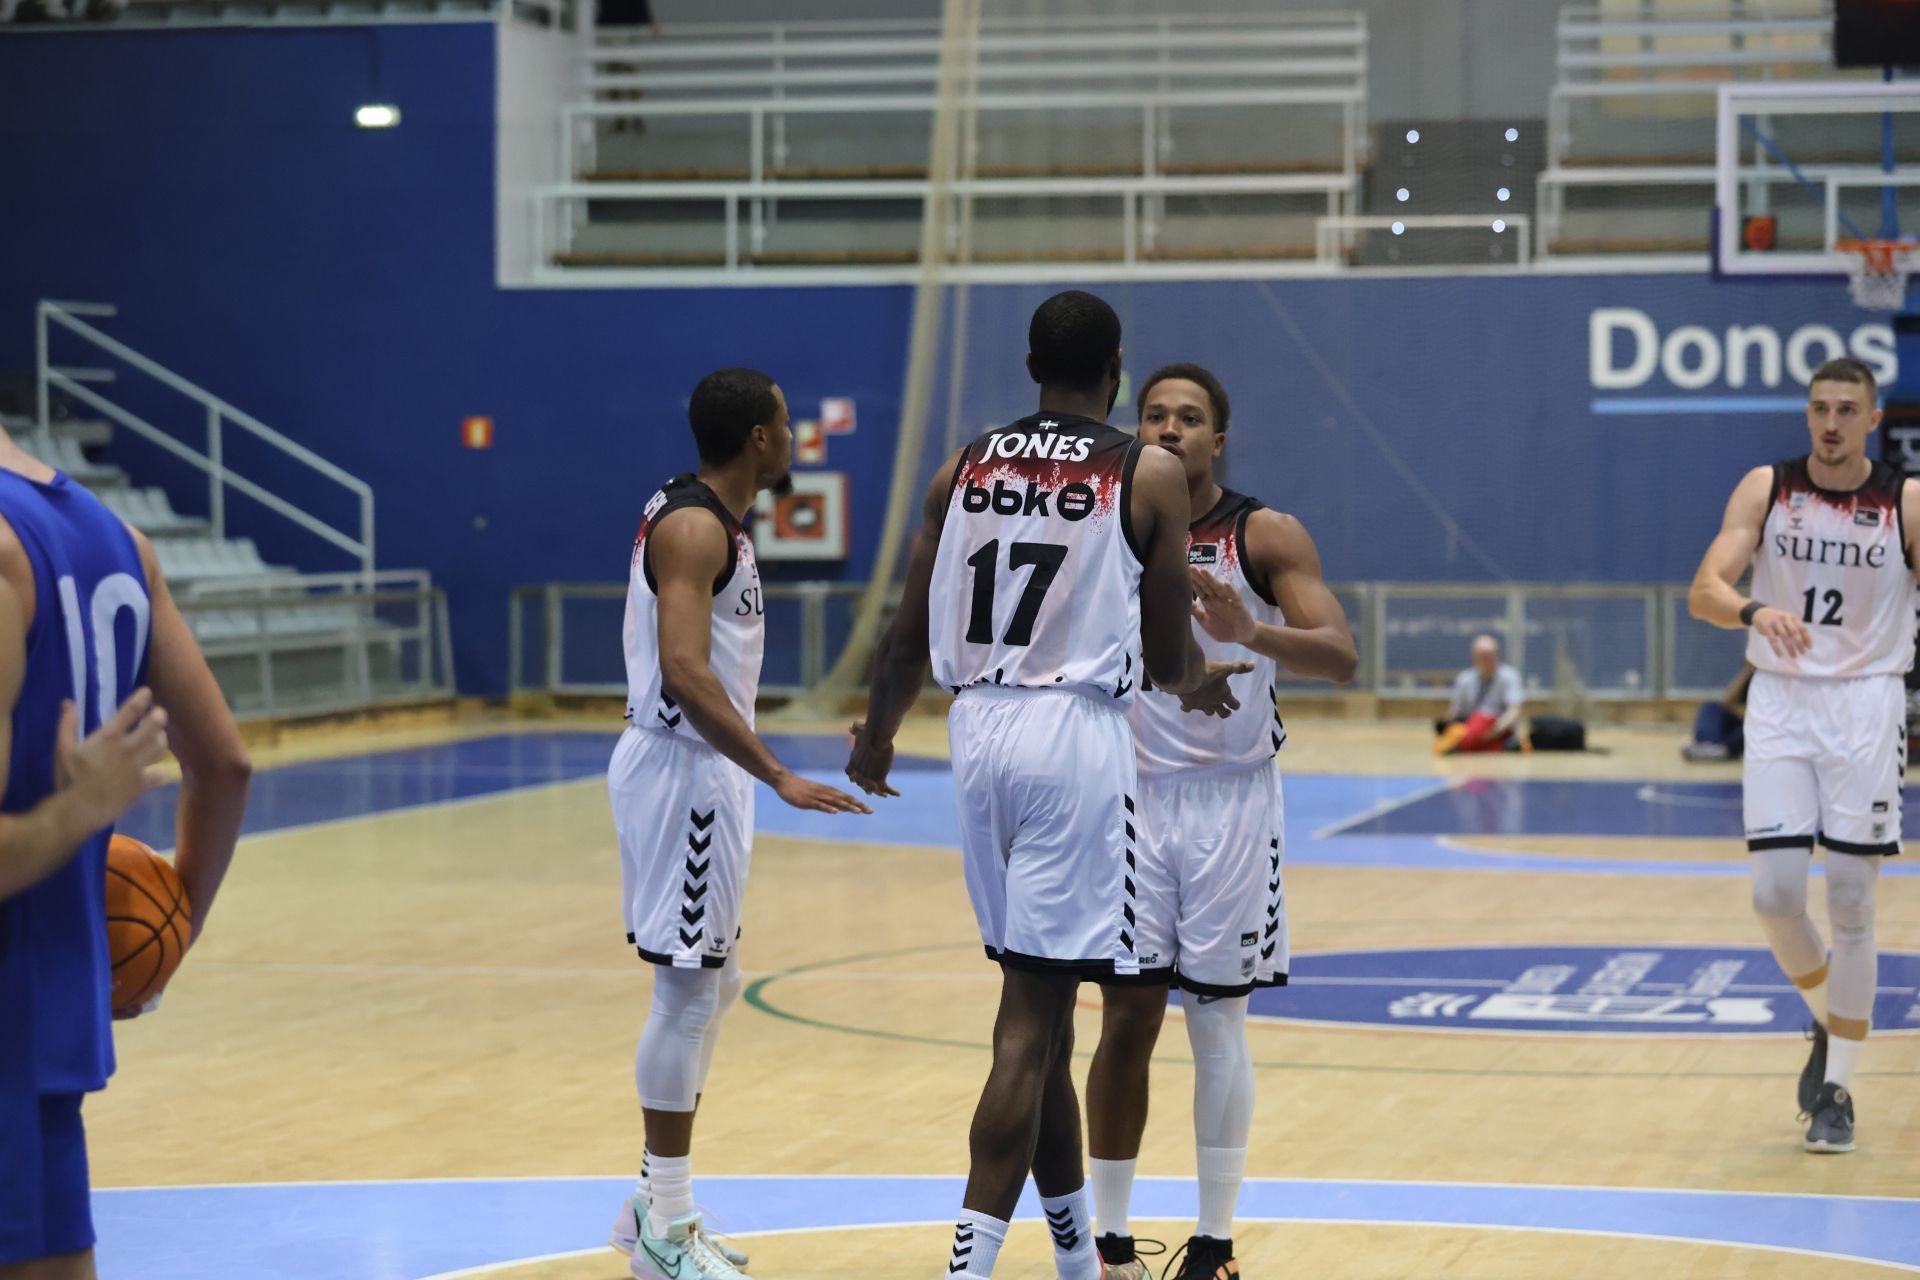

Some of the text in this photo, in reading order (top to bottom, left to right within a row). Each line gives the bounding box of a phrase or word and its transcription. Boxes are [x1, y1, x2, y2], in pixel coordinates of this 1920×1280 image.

[978, 432, 1095, 464] JONES
[962, 479, 1053, 517] bbk
[1776, 534, 1885, 568] surne
[966, 538, 1069, 646] 17
[1802, 586, 1843, 626] 12
